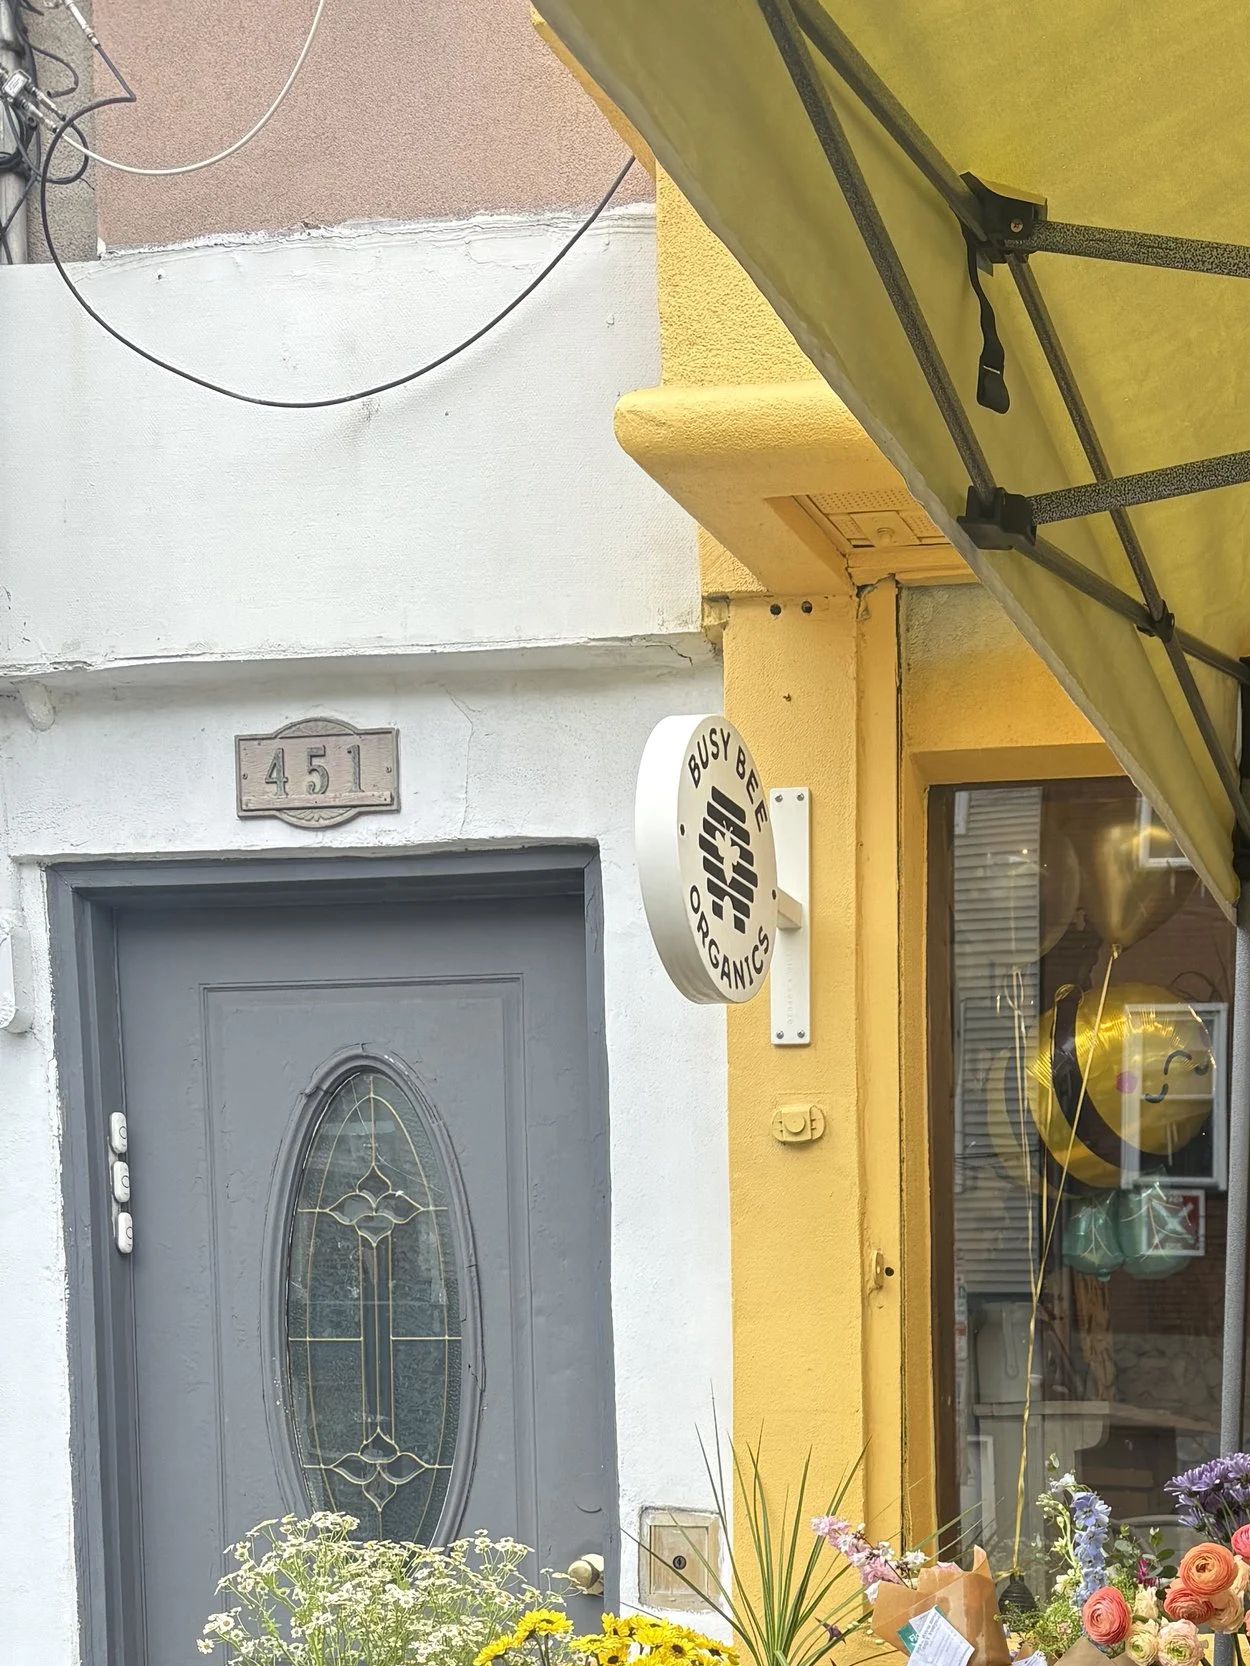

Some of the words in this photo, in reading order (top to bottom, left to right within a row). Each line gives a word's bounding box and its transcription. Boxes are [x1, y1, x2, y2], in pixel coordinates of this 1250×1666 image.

[265, 744, 364, 798] 451
[688, 727, 731, 789] BUSY
[735, 745, 769, 832] BEE
[689, 884, 770, 991] ORGANICS
